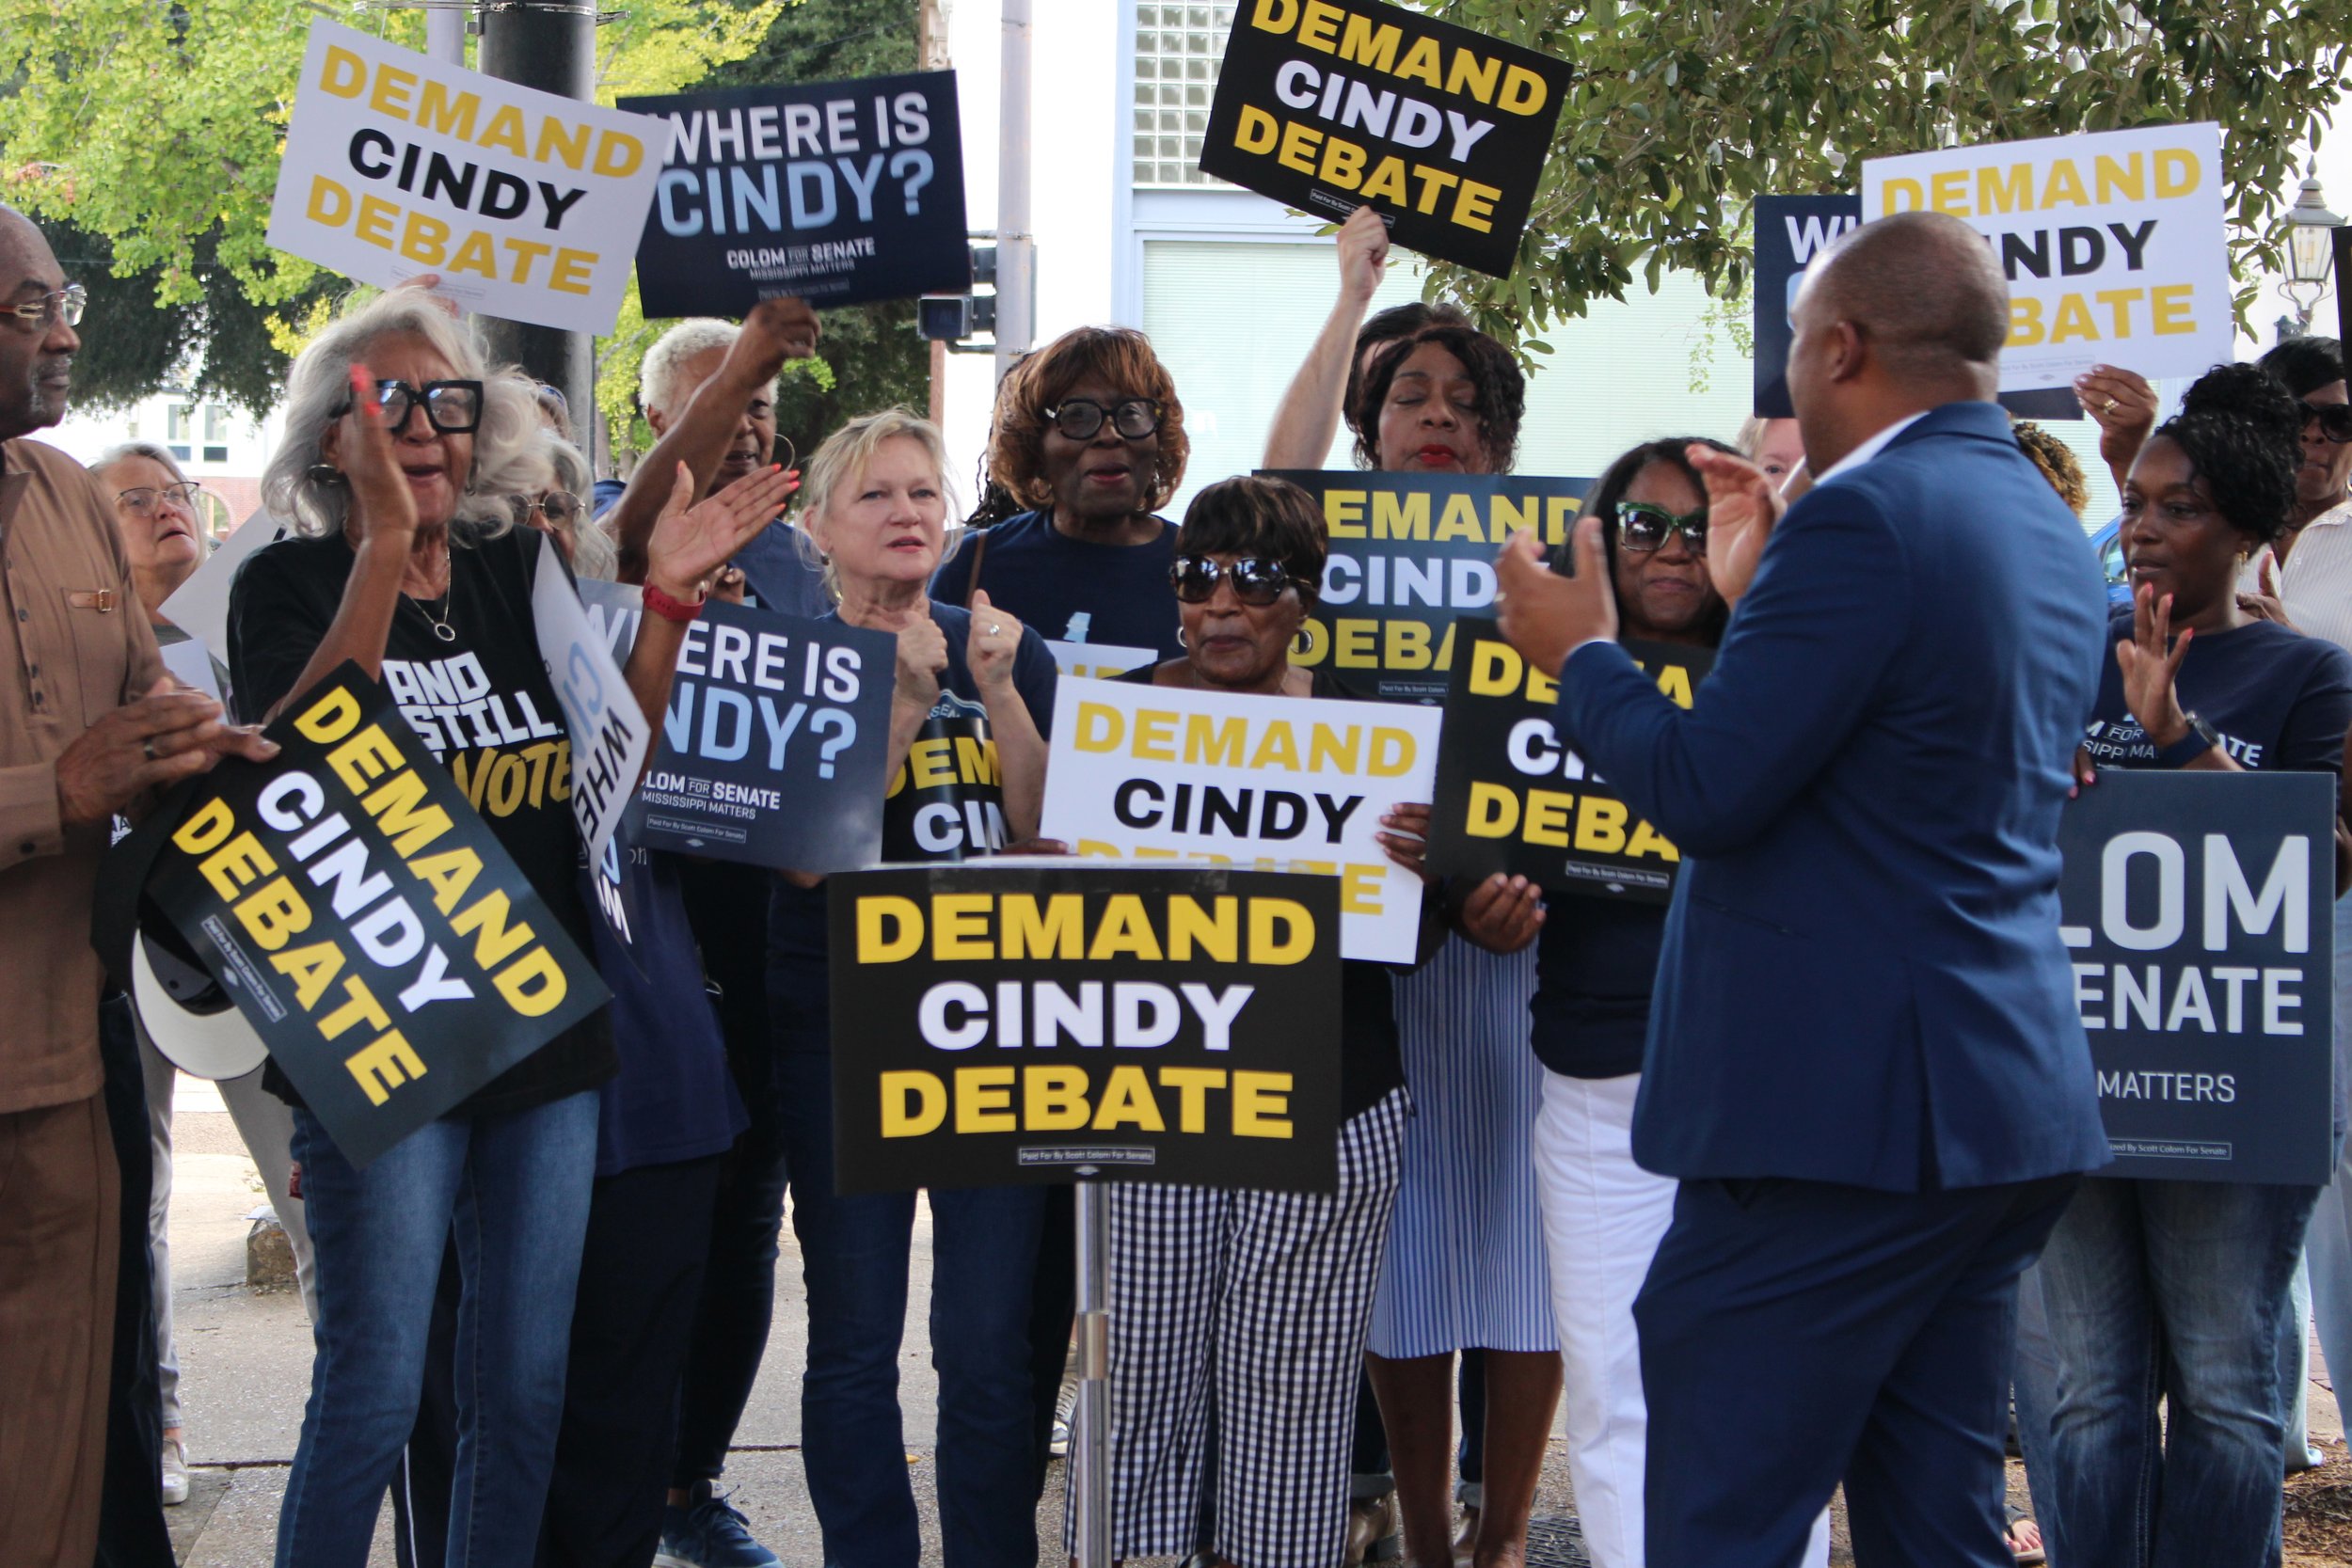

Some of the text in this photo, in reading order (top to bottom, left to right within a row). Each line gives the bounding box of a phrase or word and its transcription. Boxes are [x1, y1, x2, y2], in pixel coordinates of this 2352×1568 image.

[1251, 0, 1549, 117] DEMAND
[319, 44, 644, 179] DEMAND
[647, 91, 931, 166] WHERE IS
[1275, 59, 1496, 164] CINDY
[349, 127, 588, 231] CINDY
[658, 149, 934, 238] CINDY?
[1233, 103, 1502, 234] DEBATE
[1882, 147, 2202, 219] DEMAND
[306, 174, 600, 296] DEBATE
[726, 246, 786, 270] COLOM
[811, 236, 876, 263] SENATE
[1982, 220, 2159, 280] NDY
[2003, 284, 2198, 348] BATE
[1324, 489, 1583, 546] EMAND
[1318, 553, 1499, 609] CIND
[381, 651, 491, 705] AND
[803, 641, 862, 704] IS
[399, 690, 558, 751] STILL
[663, 681, 857, 780] NDY?
[1073, 701, 1418, 779] DEMAND
[453, 739, 571, 817] VOTE
[642, 769, 781, 810] LOM FOR SENATE
[642, 791, 756, 820] MISSISSIPPI MATTERS
[1114, 779, 1366, 845] CINDY
[293, 685, 567, 1017] DEMAND
[1466, 781, 1680, 863] DEBA
[257, 770, 475, 1012] CINDY
[171, 797, 427, 1107] DEBATE
[855, 893, 1317, 965] DEMAND
[918, 980, 1256, 1051] CINDY
[2072, 962, 2304, 1035] ENATE
[880, 1064, 1294, 1139] DEBATE
[2097, 1070, 2235, 1102] MATTERS
[2138, 1145, 2158, 1153] Scott
[2160, 1145, 2185, 1154] Colom
[2201, 1147, 2227, 1156] Senate
